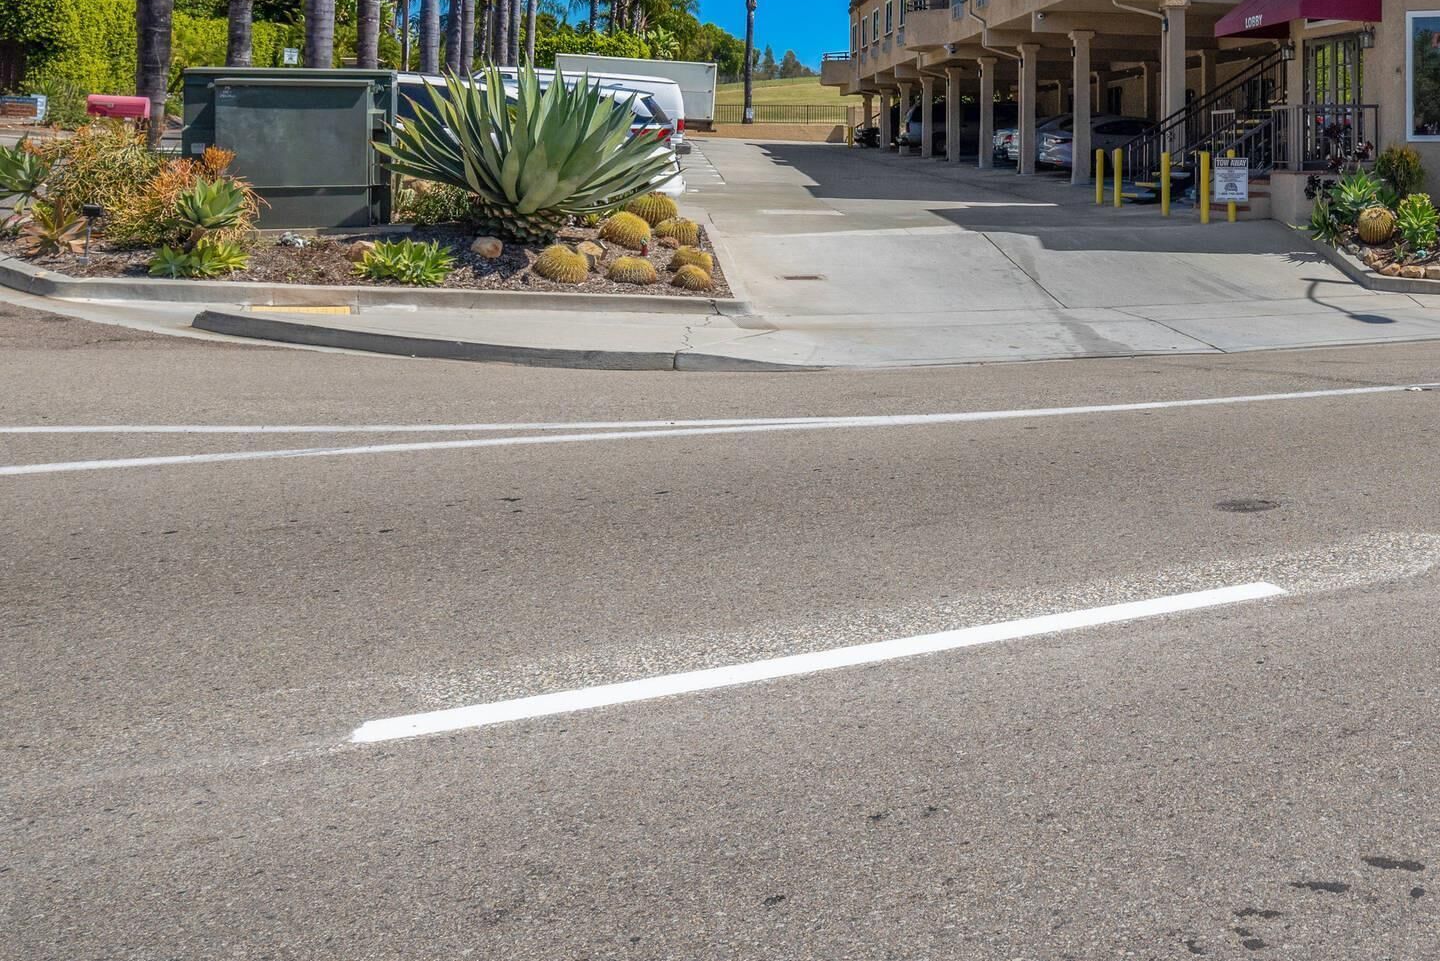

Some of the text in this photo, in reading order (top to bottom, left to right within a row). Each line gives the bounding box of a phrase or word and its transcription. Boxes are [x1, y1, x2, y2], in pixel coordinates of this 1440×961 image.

[1245, 14, 1263, 29] LOBBY
[1216, 159, 1247, 167] TOW AWAY
